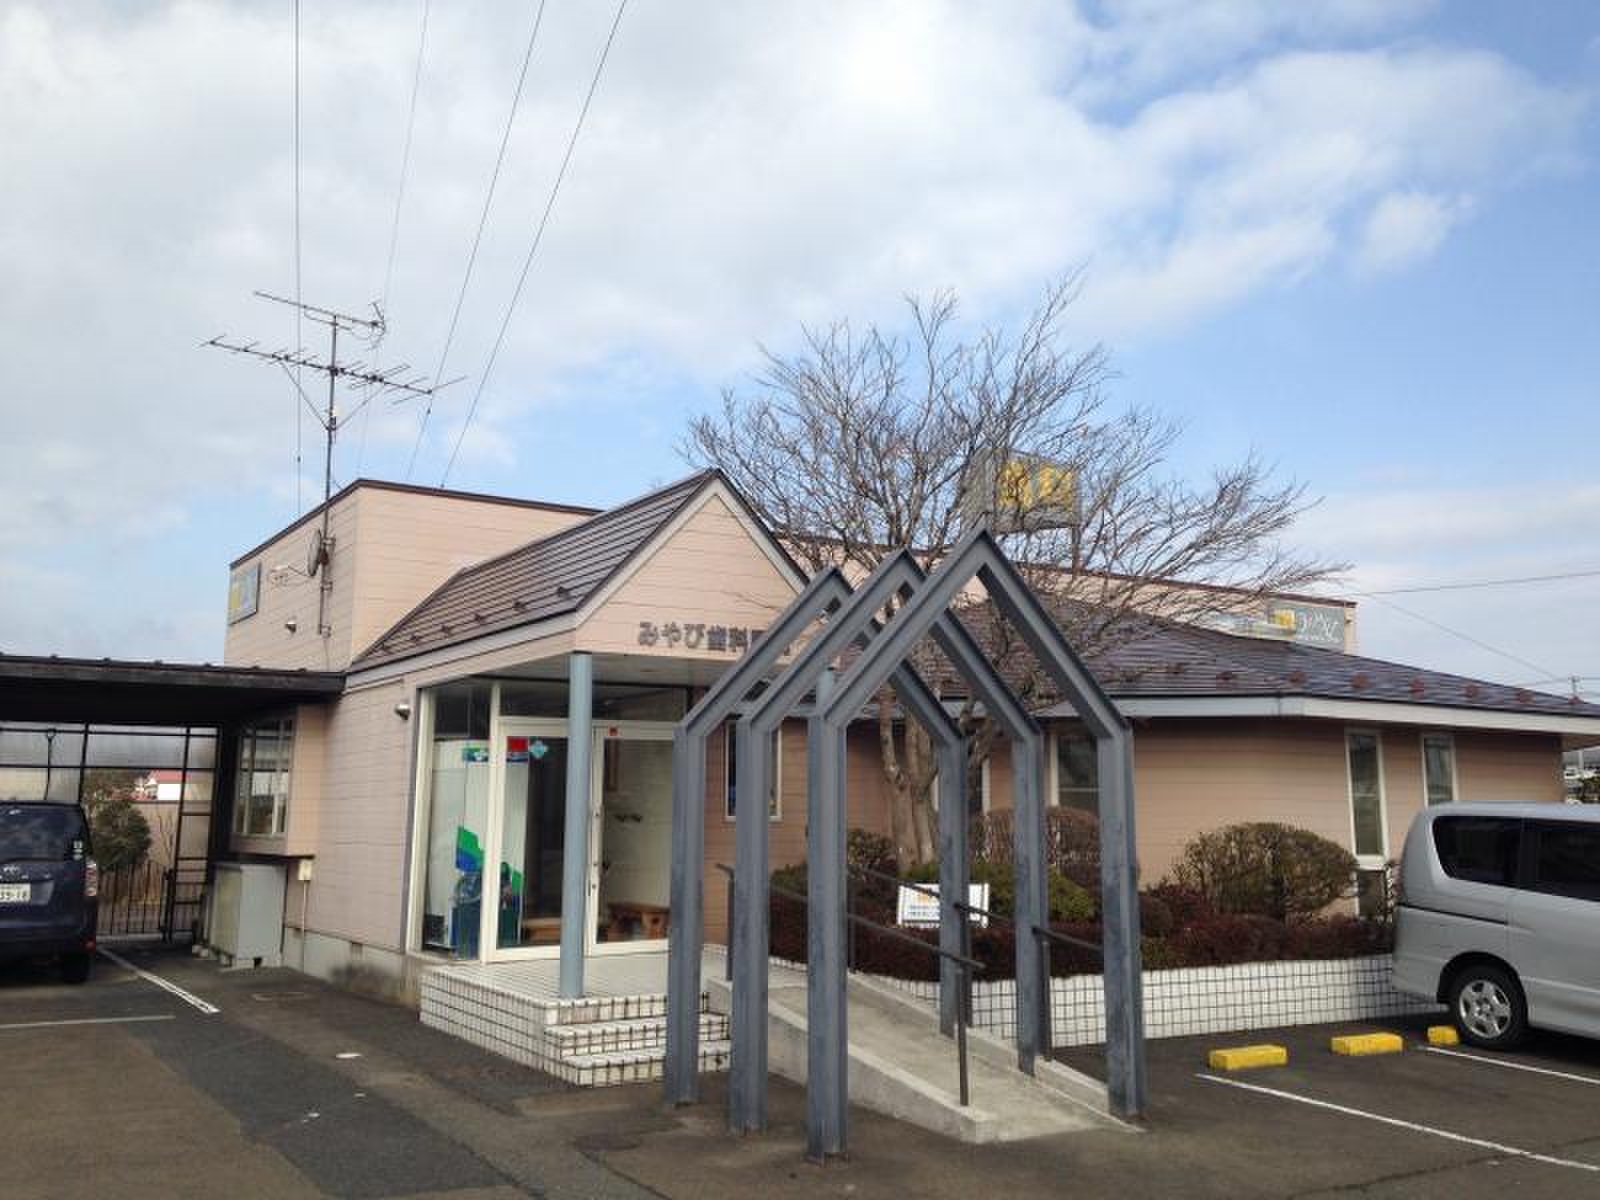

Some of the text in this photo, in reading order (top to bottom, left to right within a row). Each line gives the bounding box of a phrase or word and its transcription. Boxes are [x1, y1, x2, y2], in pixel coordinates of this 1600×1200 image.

[638, 620, 790, 655] みやび歯科
